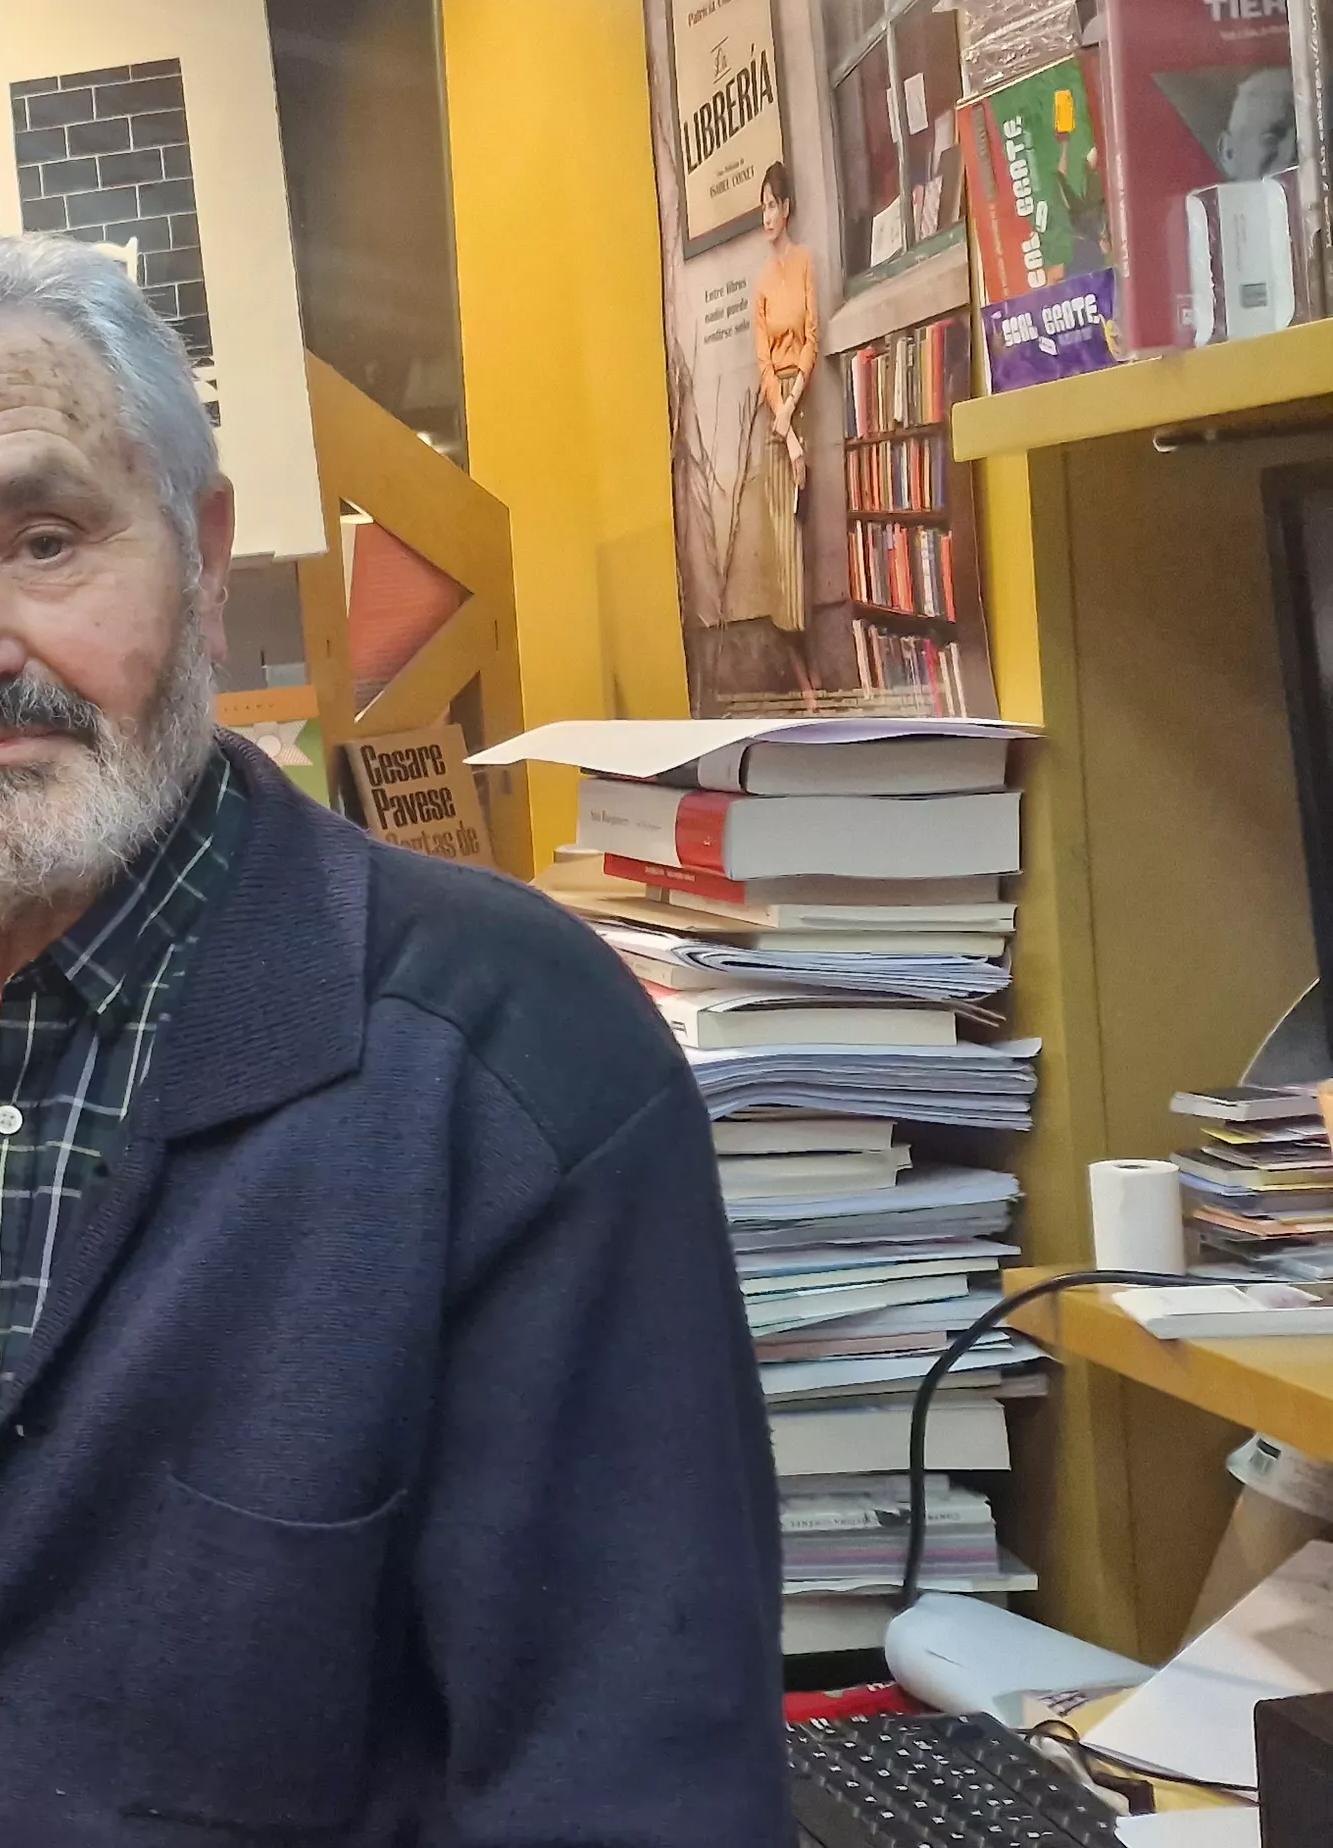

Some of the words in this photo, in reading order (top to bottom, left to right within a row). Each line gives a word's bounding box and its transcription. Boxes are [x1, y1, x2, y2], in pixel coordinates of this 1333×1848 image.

[684, 43, 774, 175] LIBRERÍA
[360, 743, 447, 788] Cesare
[371, 786, 457, 831] Pavese
[456, 820, 480, 857] de
